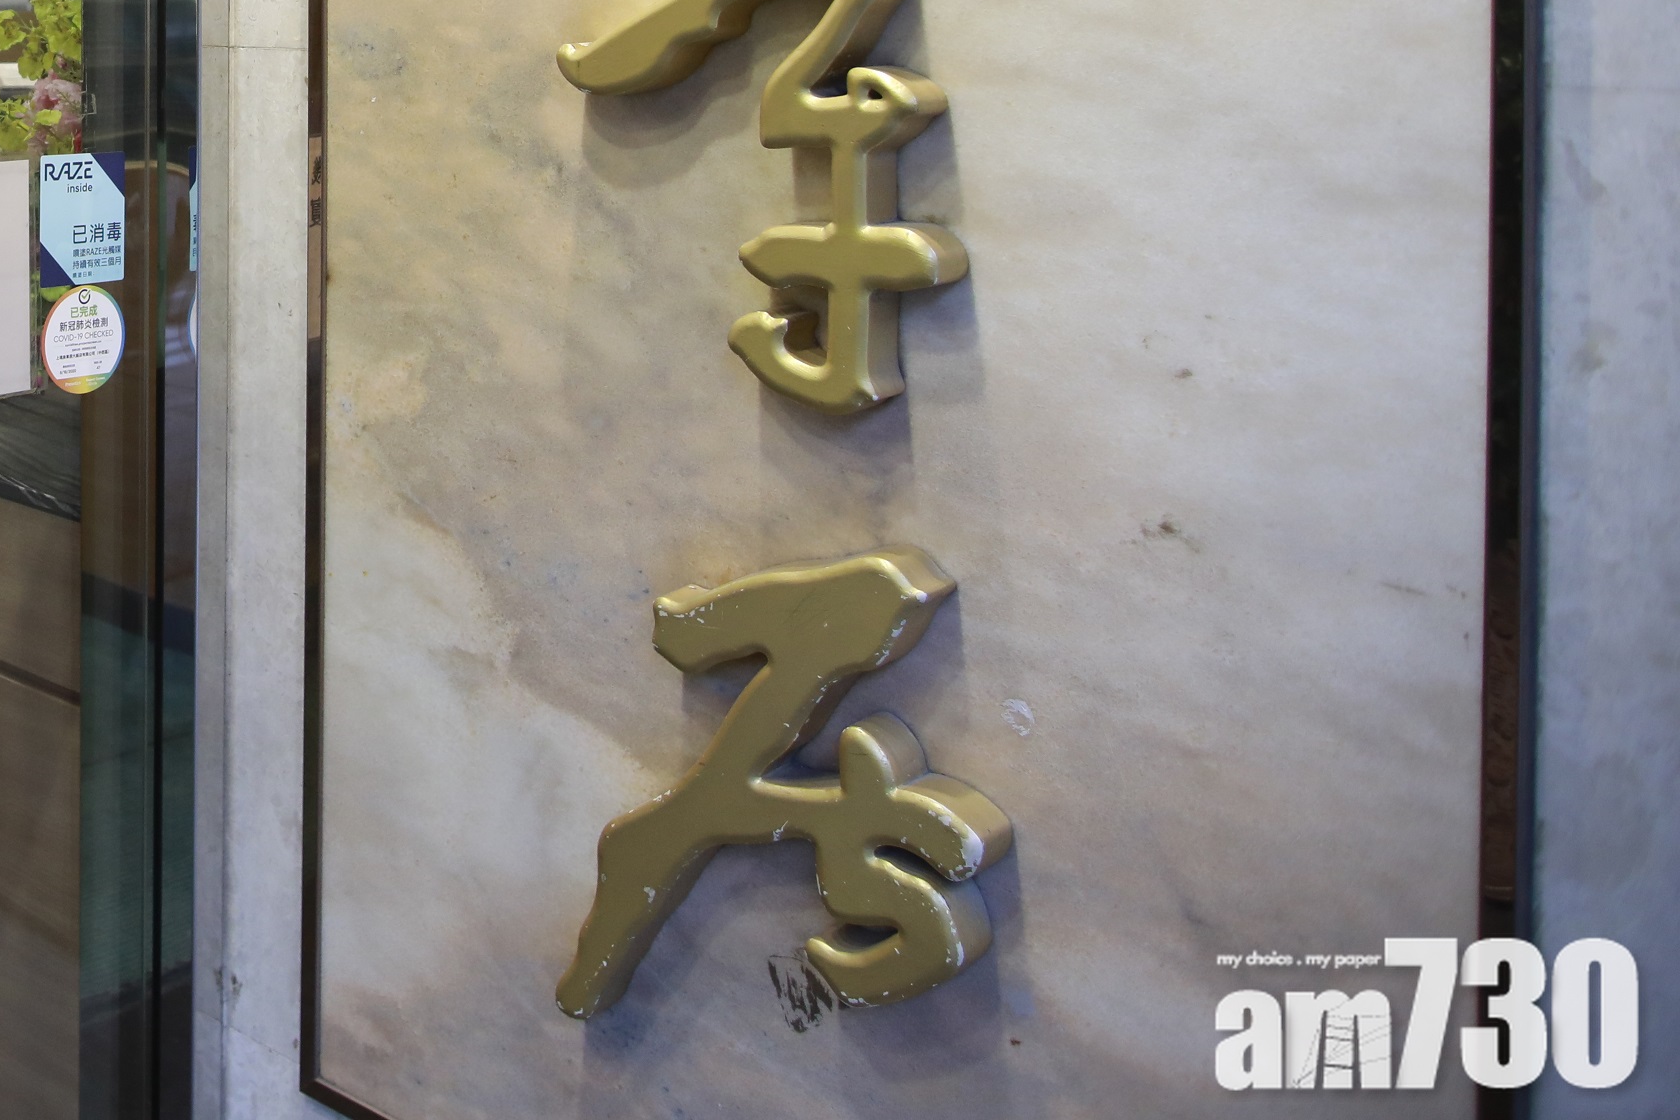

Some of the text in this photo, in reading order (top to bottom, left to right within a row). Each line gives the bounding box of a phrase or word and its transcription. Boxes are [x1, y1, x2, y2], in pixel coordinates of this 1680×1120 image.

[44, 161, 93, 182] RAZE
[66, 183, 93, 194] inside
[73, 221, 122, 244] 已消毒
[70, 304, 98, 319] 已完成
[59, 317, 109, 332] 新冠肺炎檢測
[53, 329, 114, 343] COVID-19 CHECKED
